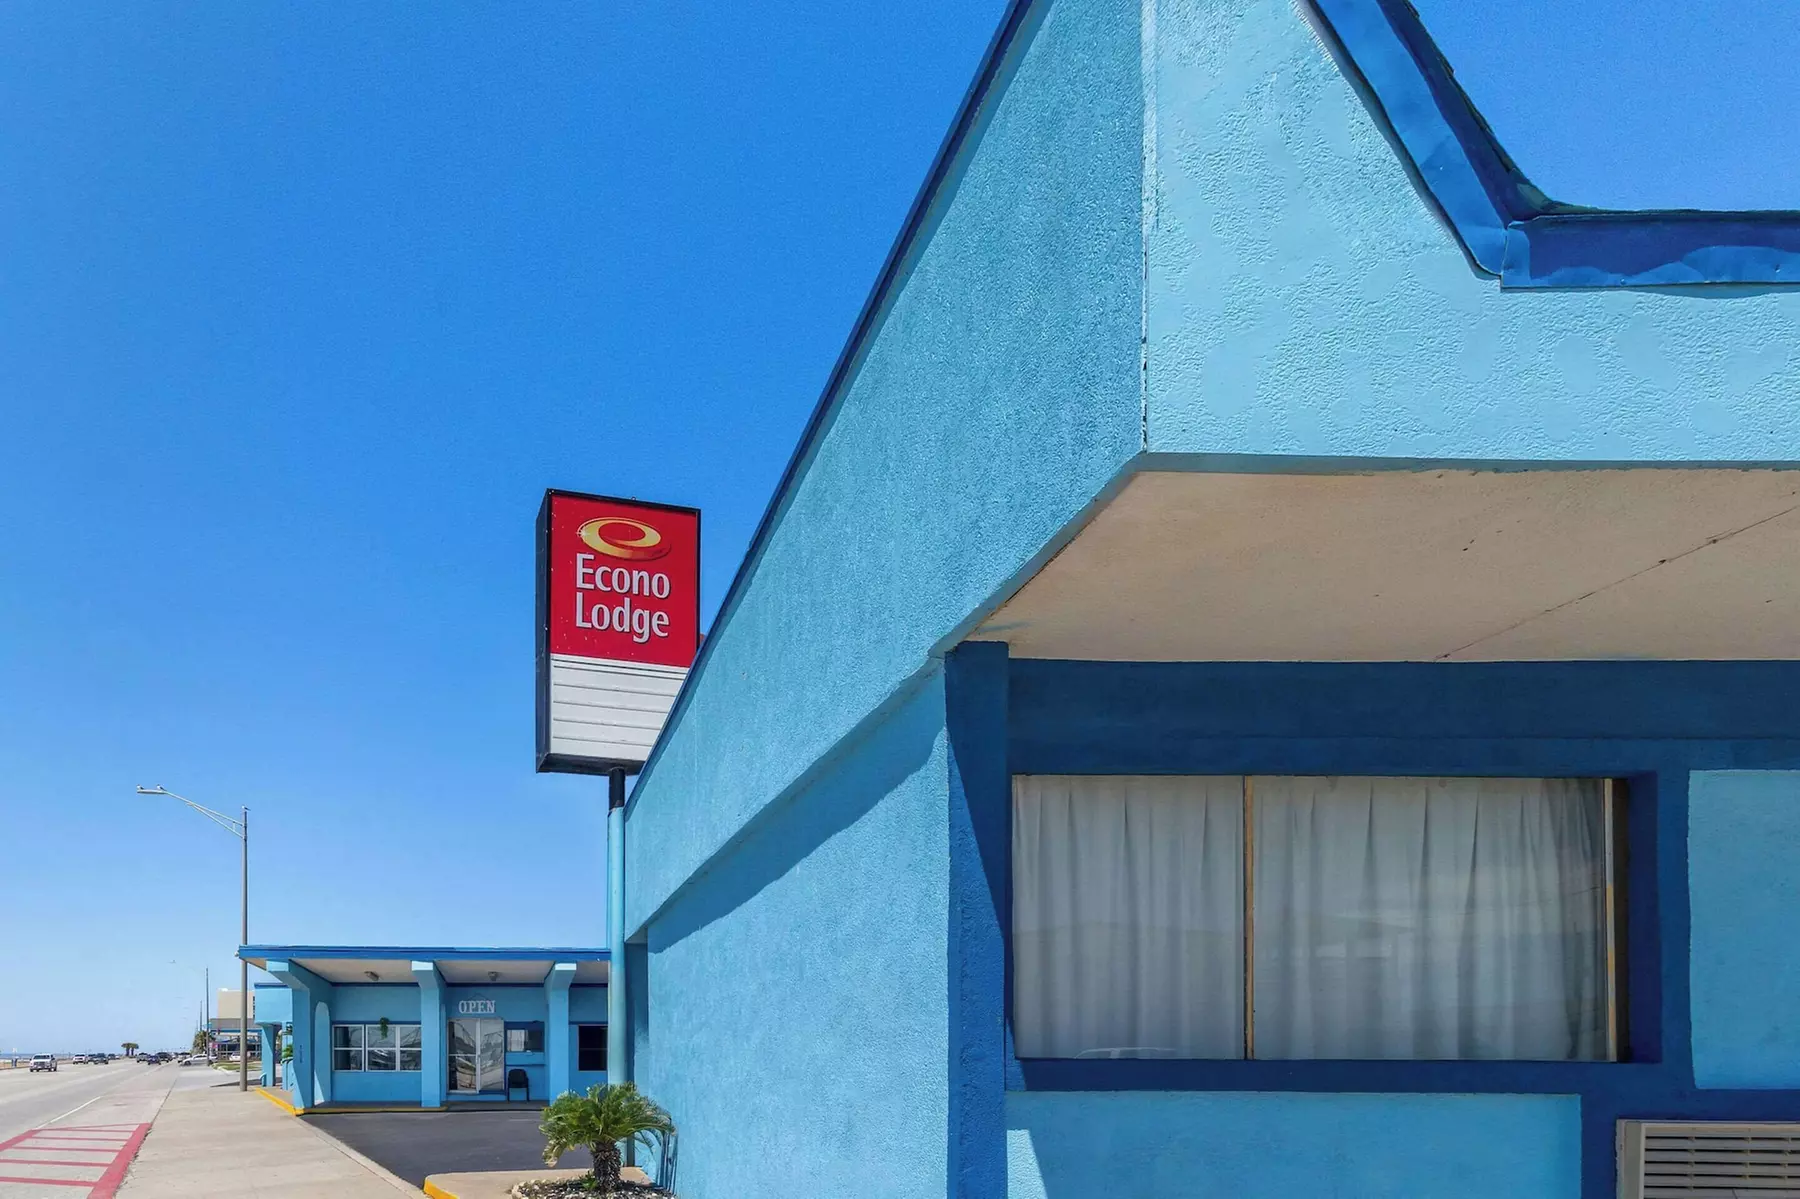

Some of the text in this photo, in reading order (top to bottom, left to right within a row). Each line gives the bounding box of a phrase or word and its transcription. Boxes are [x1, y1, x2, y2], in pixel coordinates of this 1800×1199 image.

[576, 552, 671, 599] Econo
[576, 591, 670, 644] Lodge
[458, 1000, 496, 1014] OPEN
